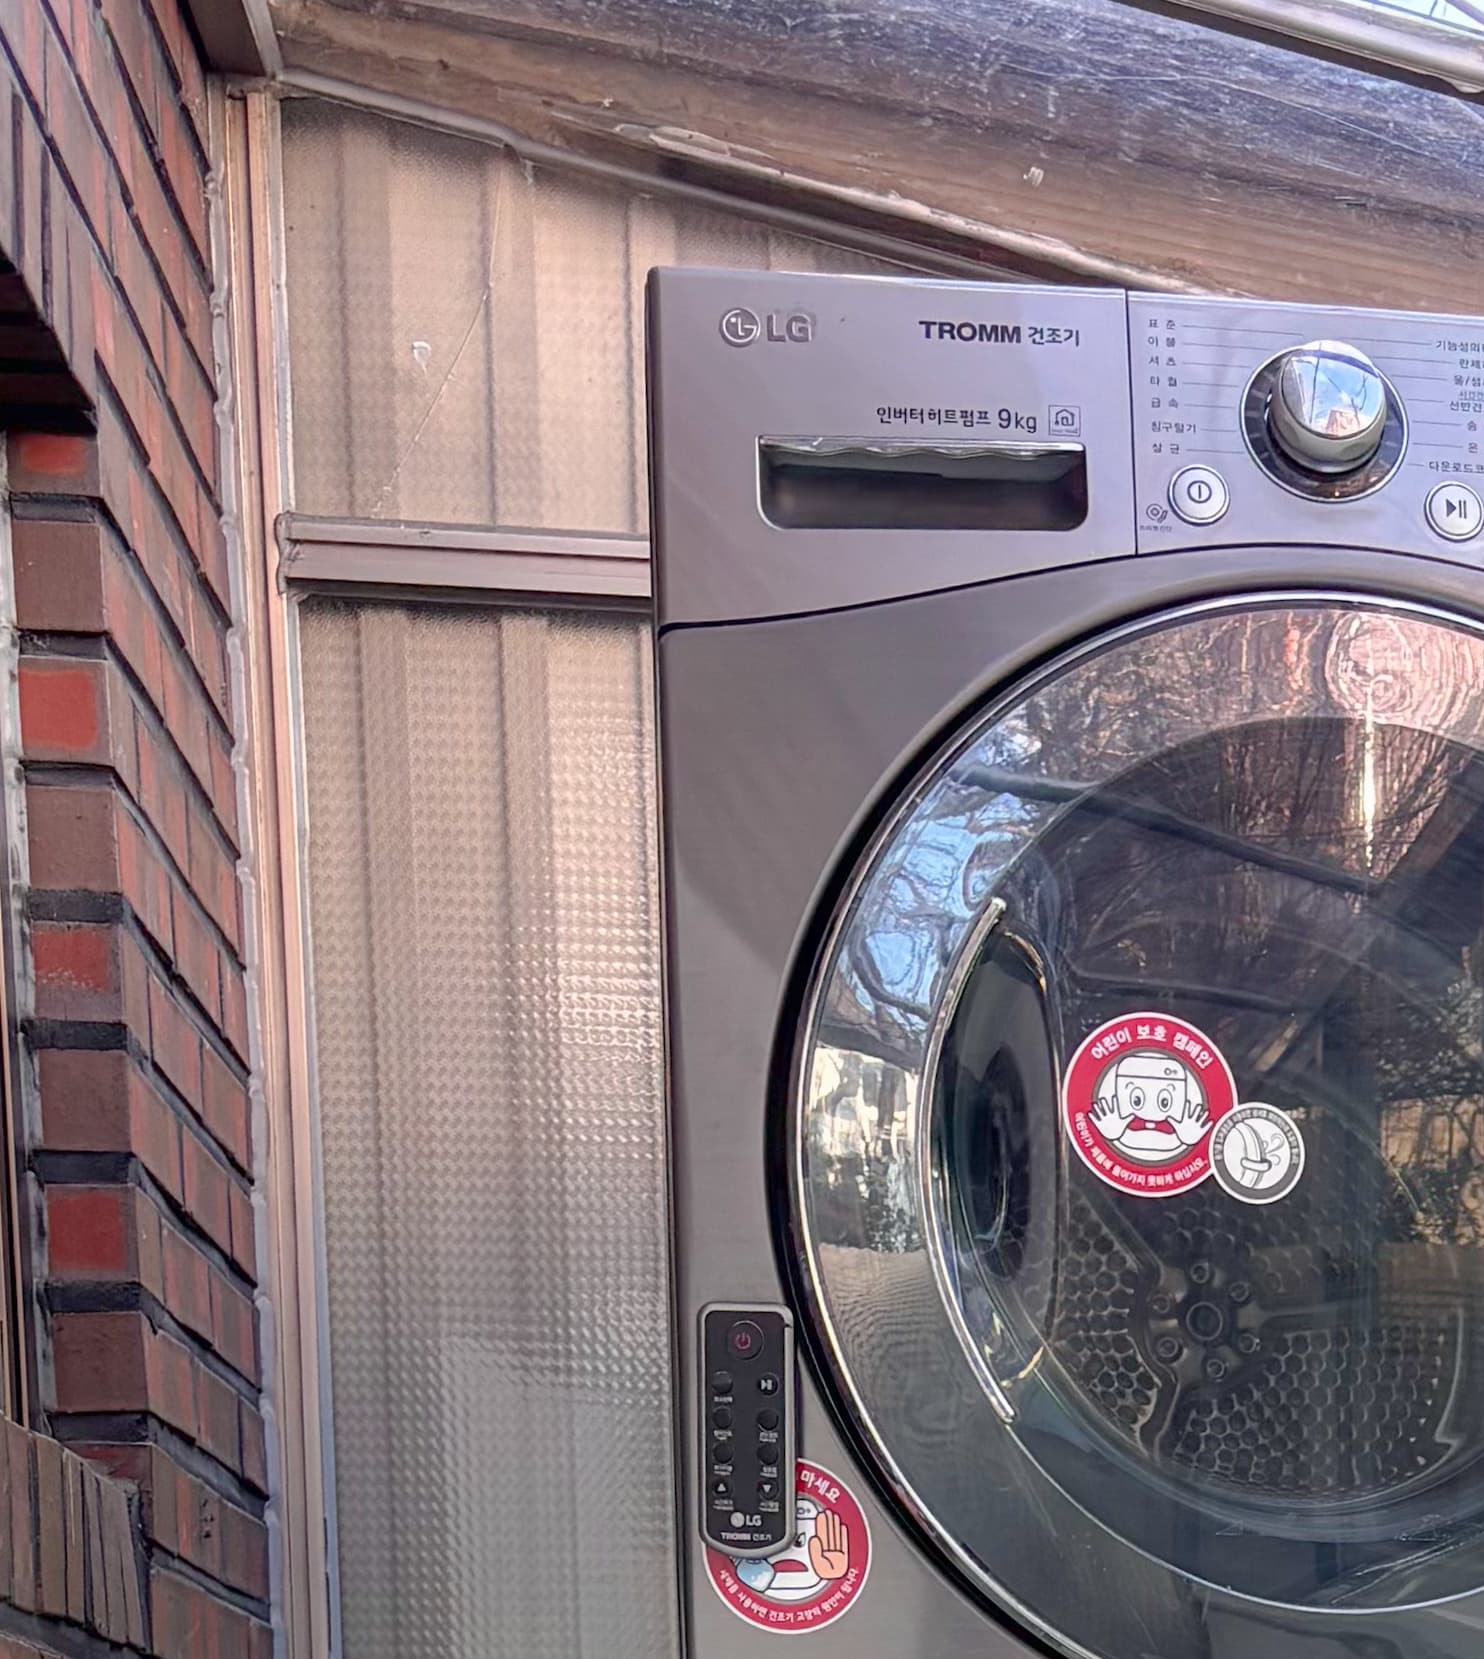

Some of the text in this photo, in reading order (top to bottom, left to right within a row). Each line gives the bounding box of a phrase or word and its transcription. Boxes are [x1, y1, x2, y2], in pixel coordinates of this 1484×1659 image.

[767, 314, 812, 341] LG
[918, 320, 1080, 346] TROMM 건조기
[877, 406, 990, 427] 인버터히트펌프
[1091, 1024, 1214, 1070] 어린이 보호 캠페인
[800, 1469, 840, 1504] 마세요
[746, 1515, 761, 1527] LG
